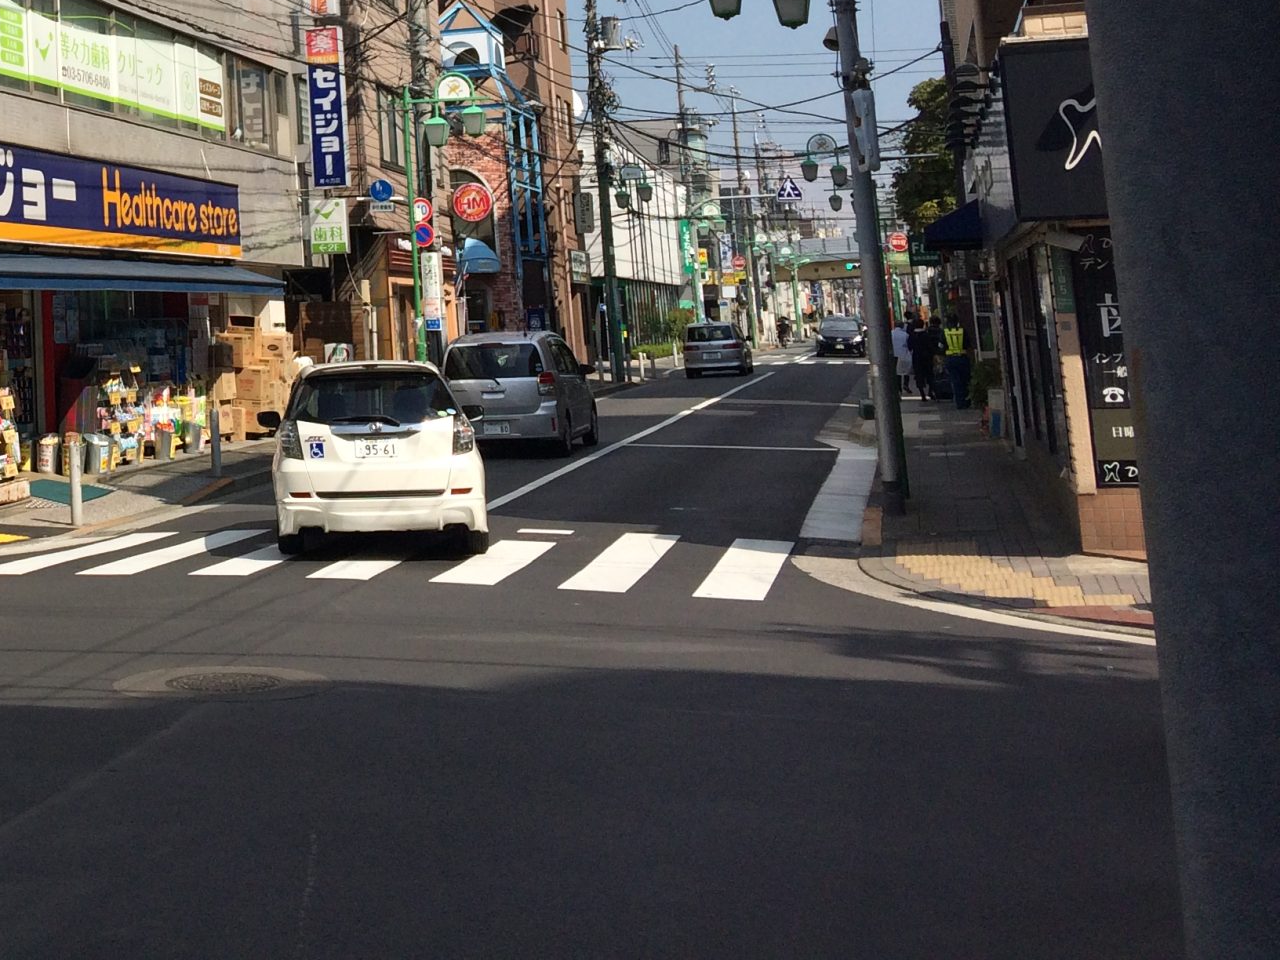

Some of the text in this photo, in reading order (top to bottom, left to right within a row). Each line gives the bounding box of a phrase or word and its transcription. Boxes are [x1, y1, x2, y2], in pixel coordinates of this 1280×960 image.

[311, 30, 333, 54] 薬
[313, 68, 340, 176] セイジョー
[103, 167, 237, 237] Healthcare store
[458, 197, 486, 210] HM
[313, 225, 342, 241] 歯科
